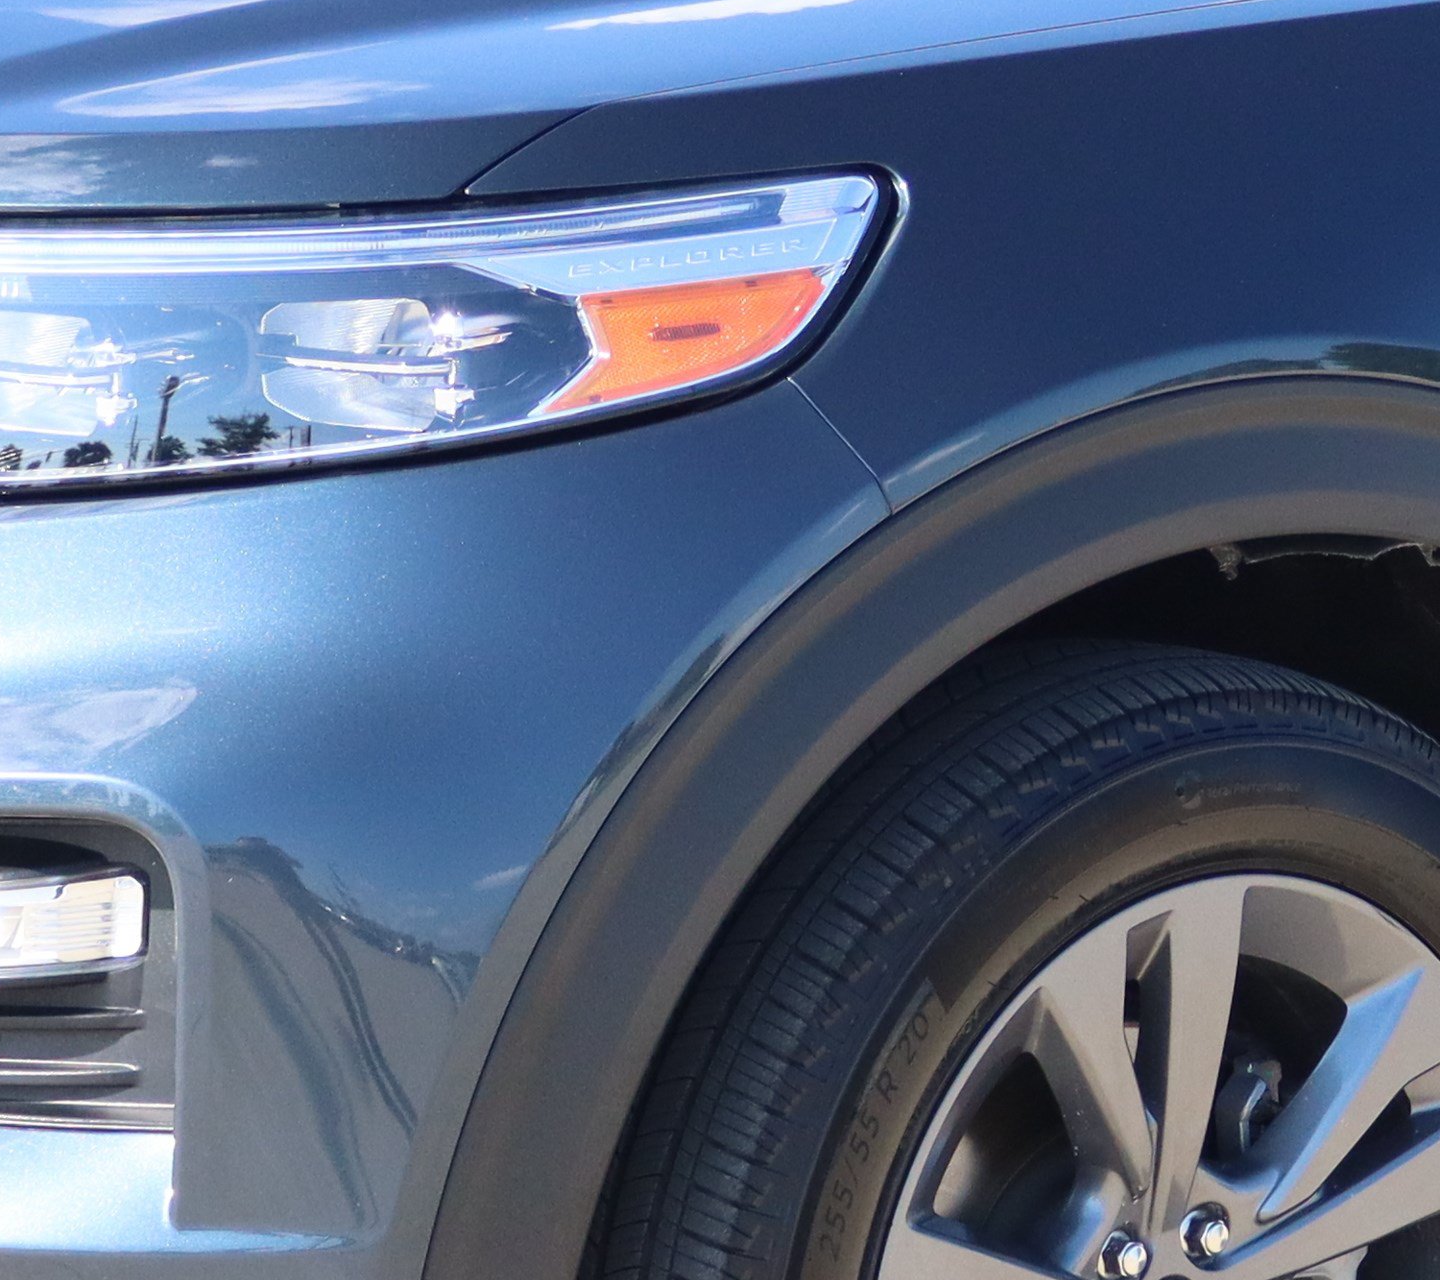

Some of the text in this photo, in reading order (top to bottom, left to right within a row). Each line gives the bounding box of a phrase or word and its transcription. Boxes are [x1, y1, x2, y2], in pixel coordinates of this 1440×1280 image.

[567, 238, 809, 279] EXPLORER
[819, 1012, 930, 1263] 255/55 R 20
